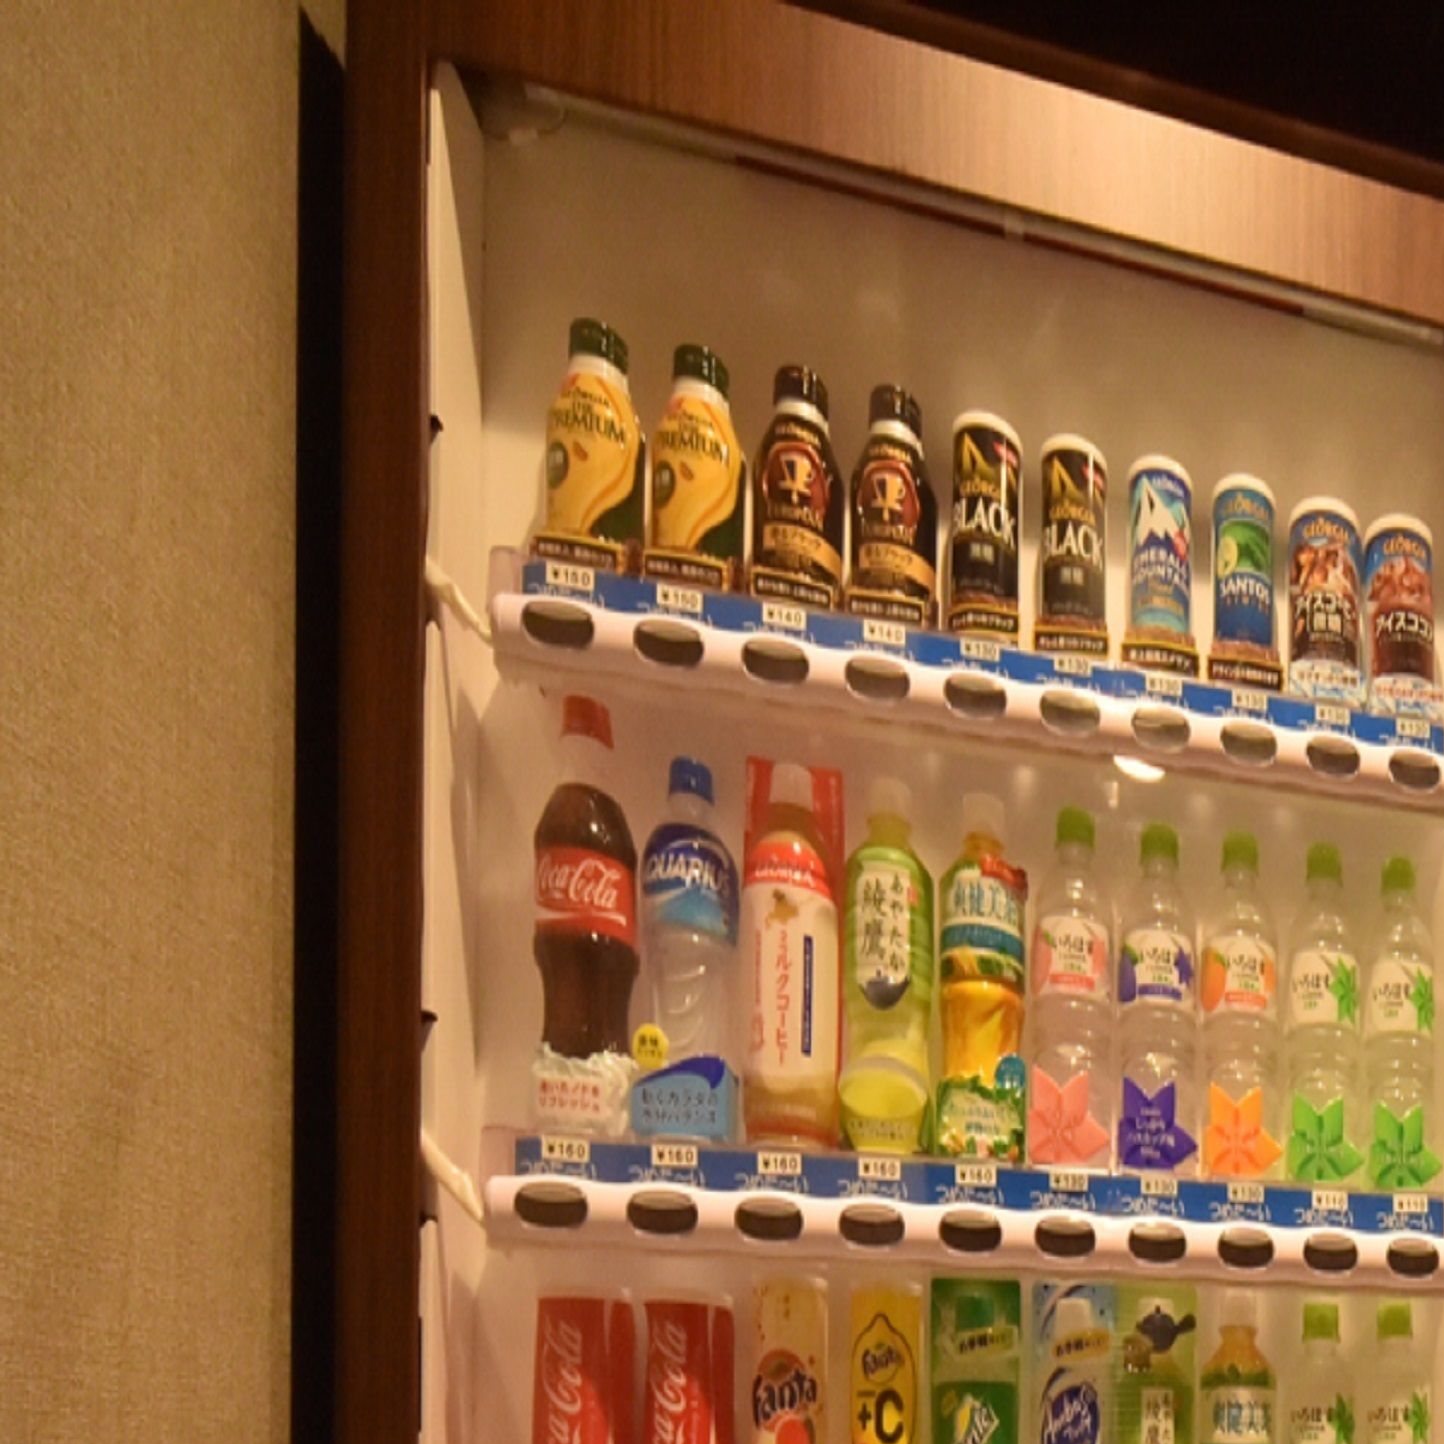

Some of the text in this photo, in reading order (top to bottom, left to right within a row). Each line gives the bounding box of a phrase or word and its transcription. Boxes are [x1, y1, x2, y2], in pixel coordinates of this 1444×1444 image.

[775, 930, 793, 1067] ミルクコーヒー
[753, 1368, 817, 1429] Fanta
